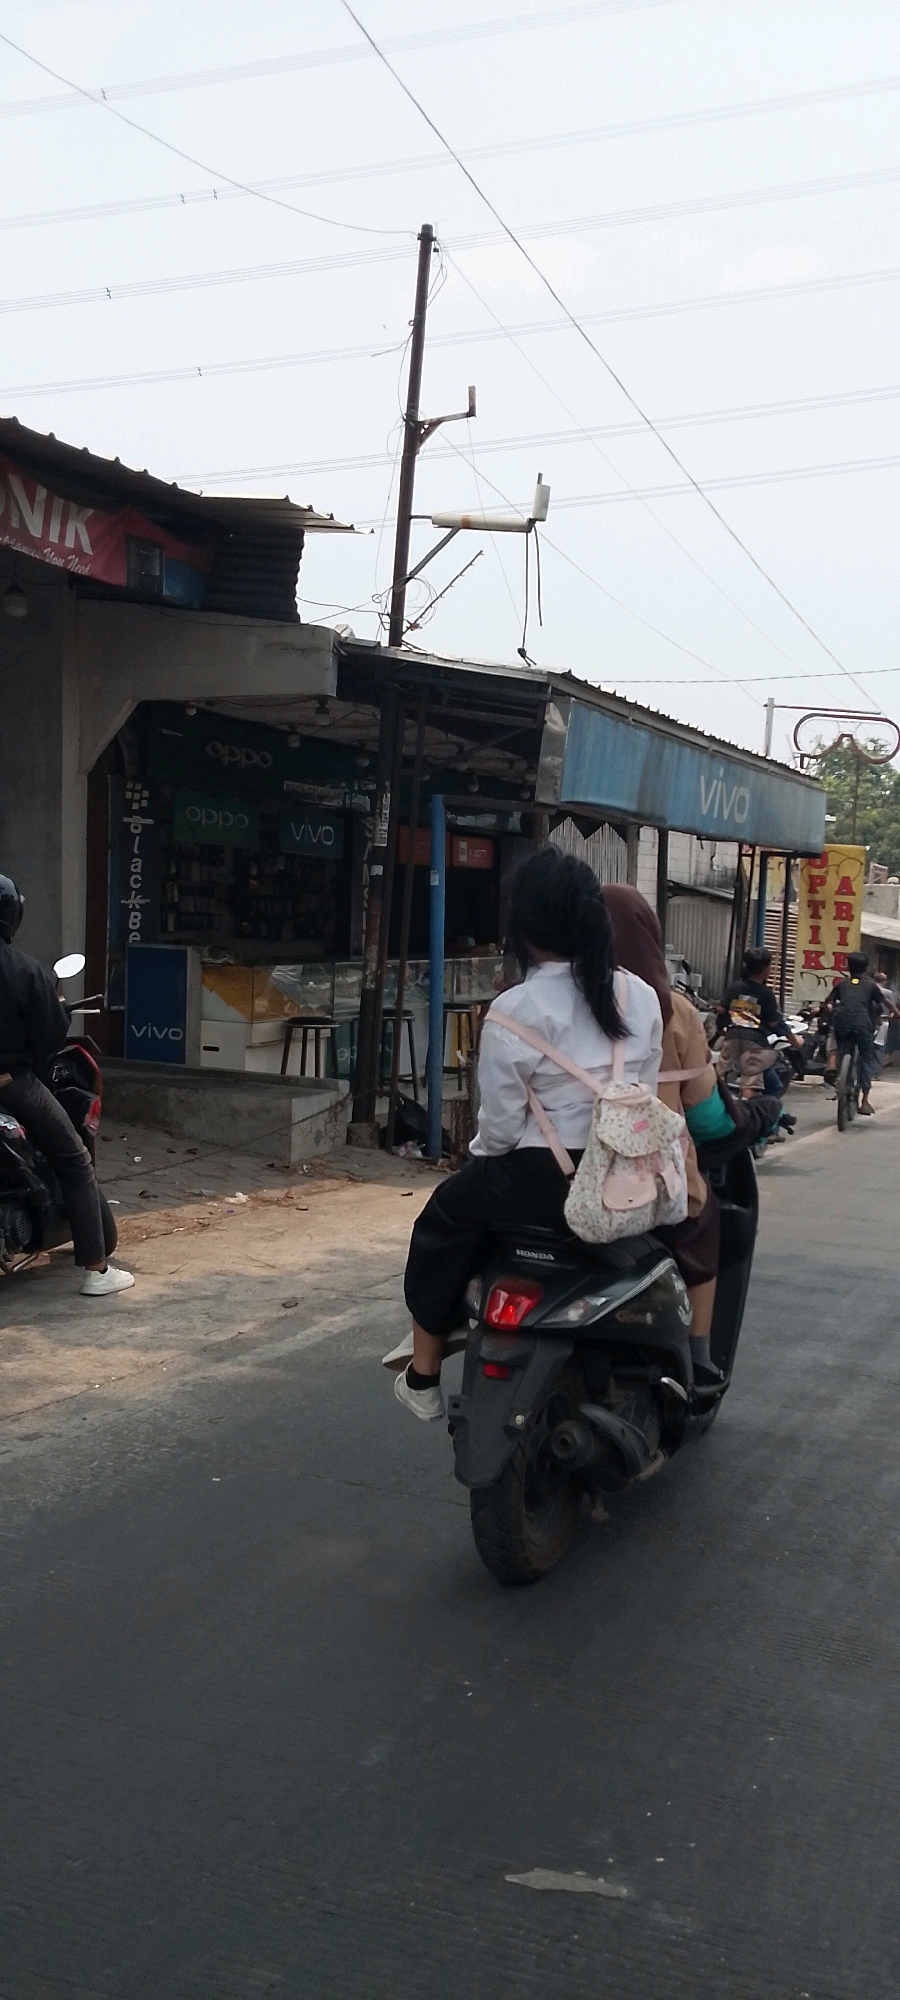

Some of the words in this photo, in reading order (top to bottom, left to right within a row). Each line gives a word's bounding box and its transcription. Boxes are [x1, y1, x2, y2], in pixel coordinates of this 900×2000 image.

[206, 739, 274, 770] oppo
[700, 766, 750, 823] vivo
[185, 805, 249, 829] oppo
[290, 817, 335, 846] vivo
[802, 851, 829, 971] OPTIK
[130, 1022, 184, 1041] vivo
[515, 1248, 555, 1262] HONDA
